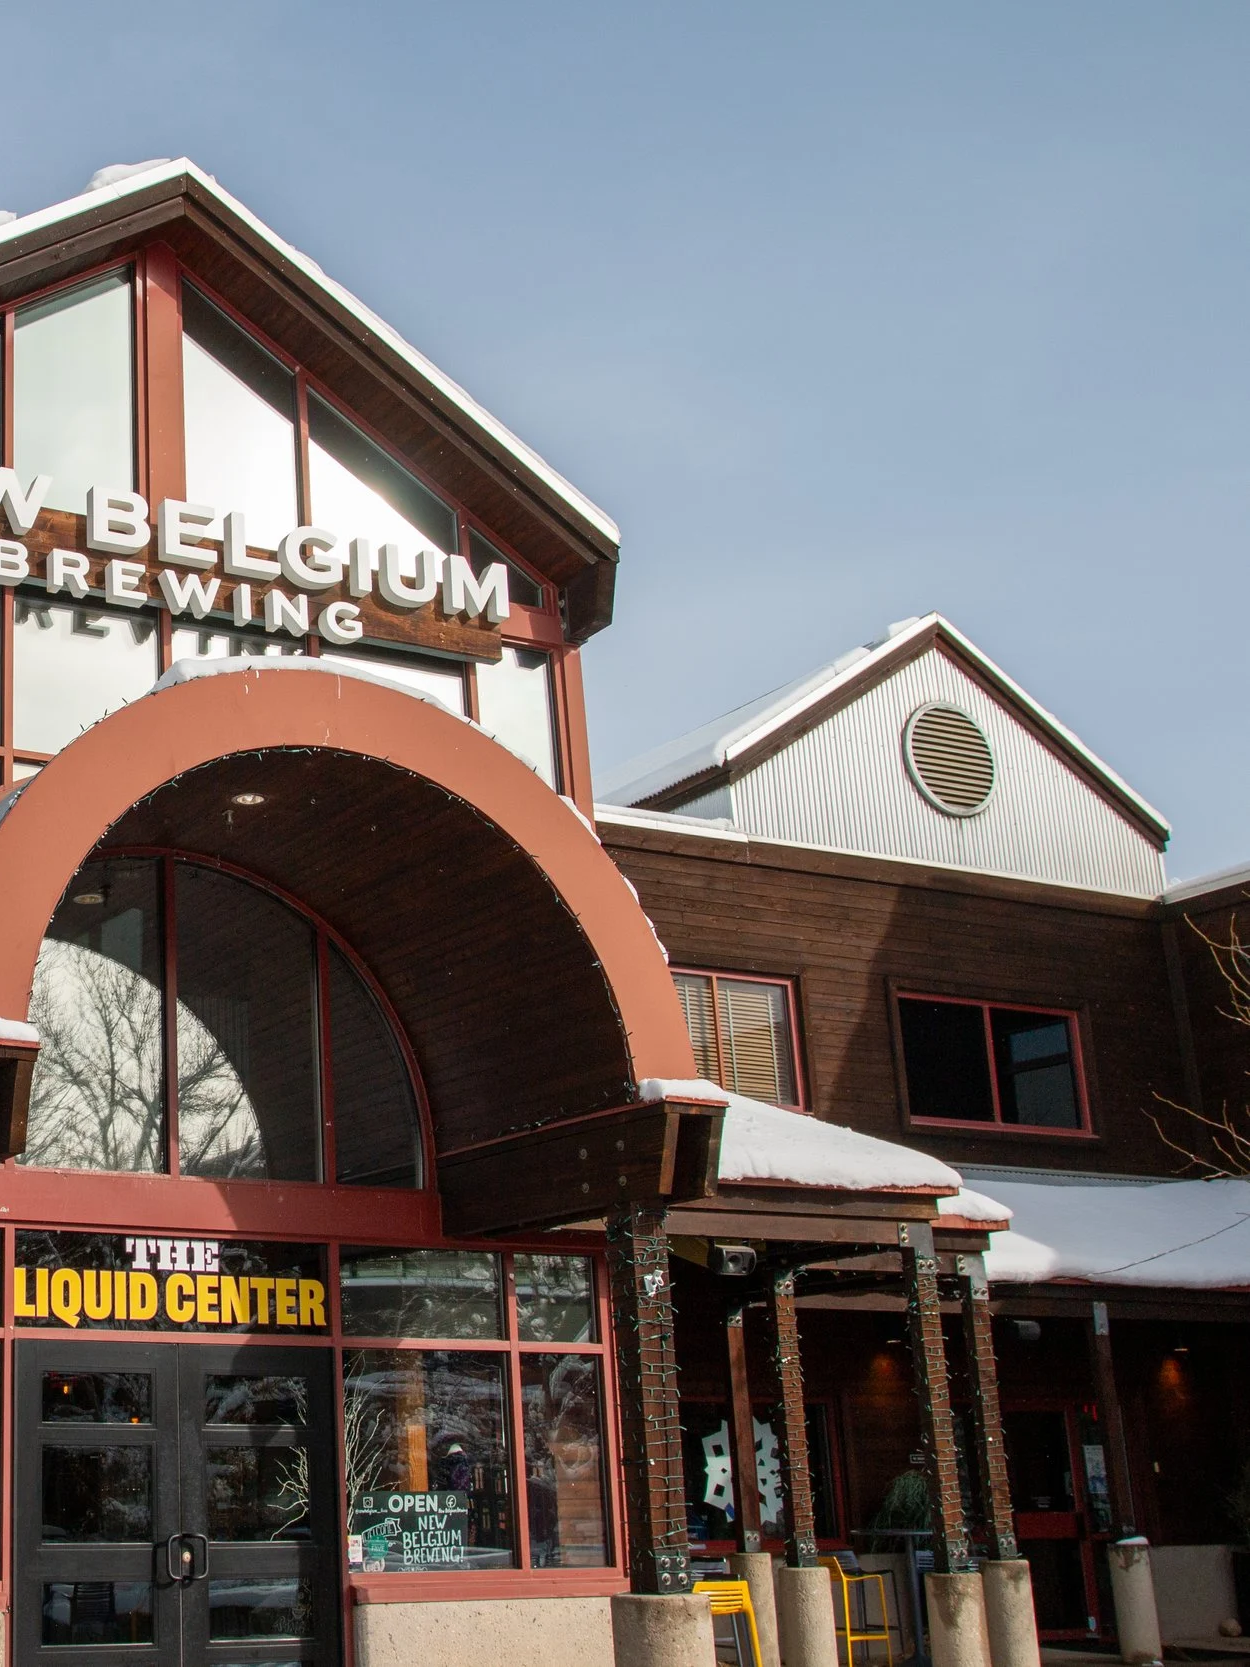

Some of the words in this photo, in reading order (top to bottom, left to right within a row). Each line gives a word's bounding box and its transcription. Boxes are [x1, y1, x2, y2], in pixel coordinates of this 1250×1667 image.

[87, 485, 510, 625] BELGIUM
[125, 1237, 219, 1272] THE
[13, 1267, 158, 1328] LIQUID
[165, 1273, 327, 1326] CENTER
[388, 1494, 438, 1512] OPEN
[418, 1514, 448, 1531] NEW
[402, 1529, 462, 1549] BELGIUM
[403, 1546, 465, 1565] BREWING!
